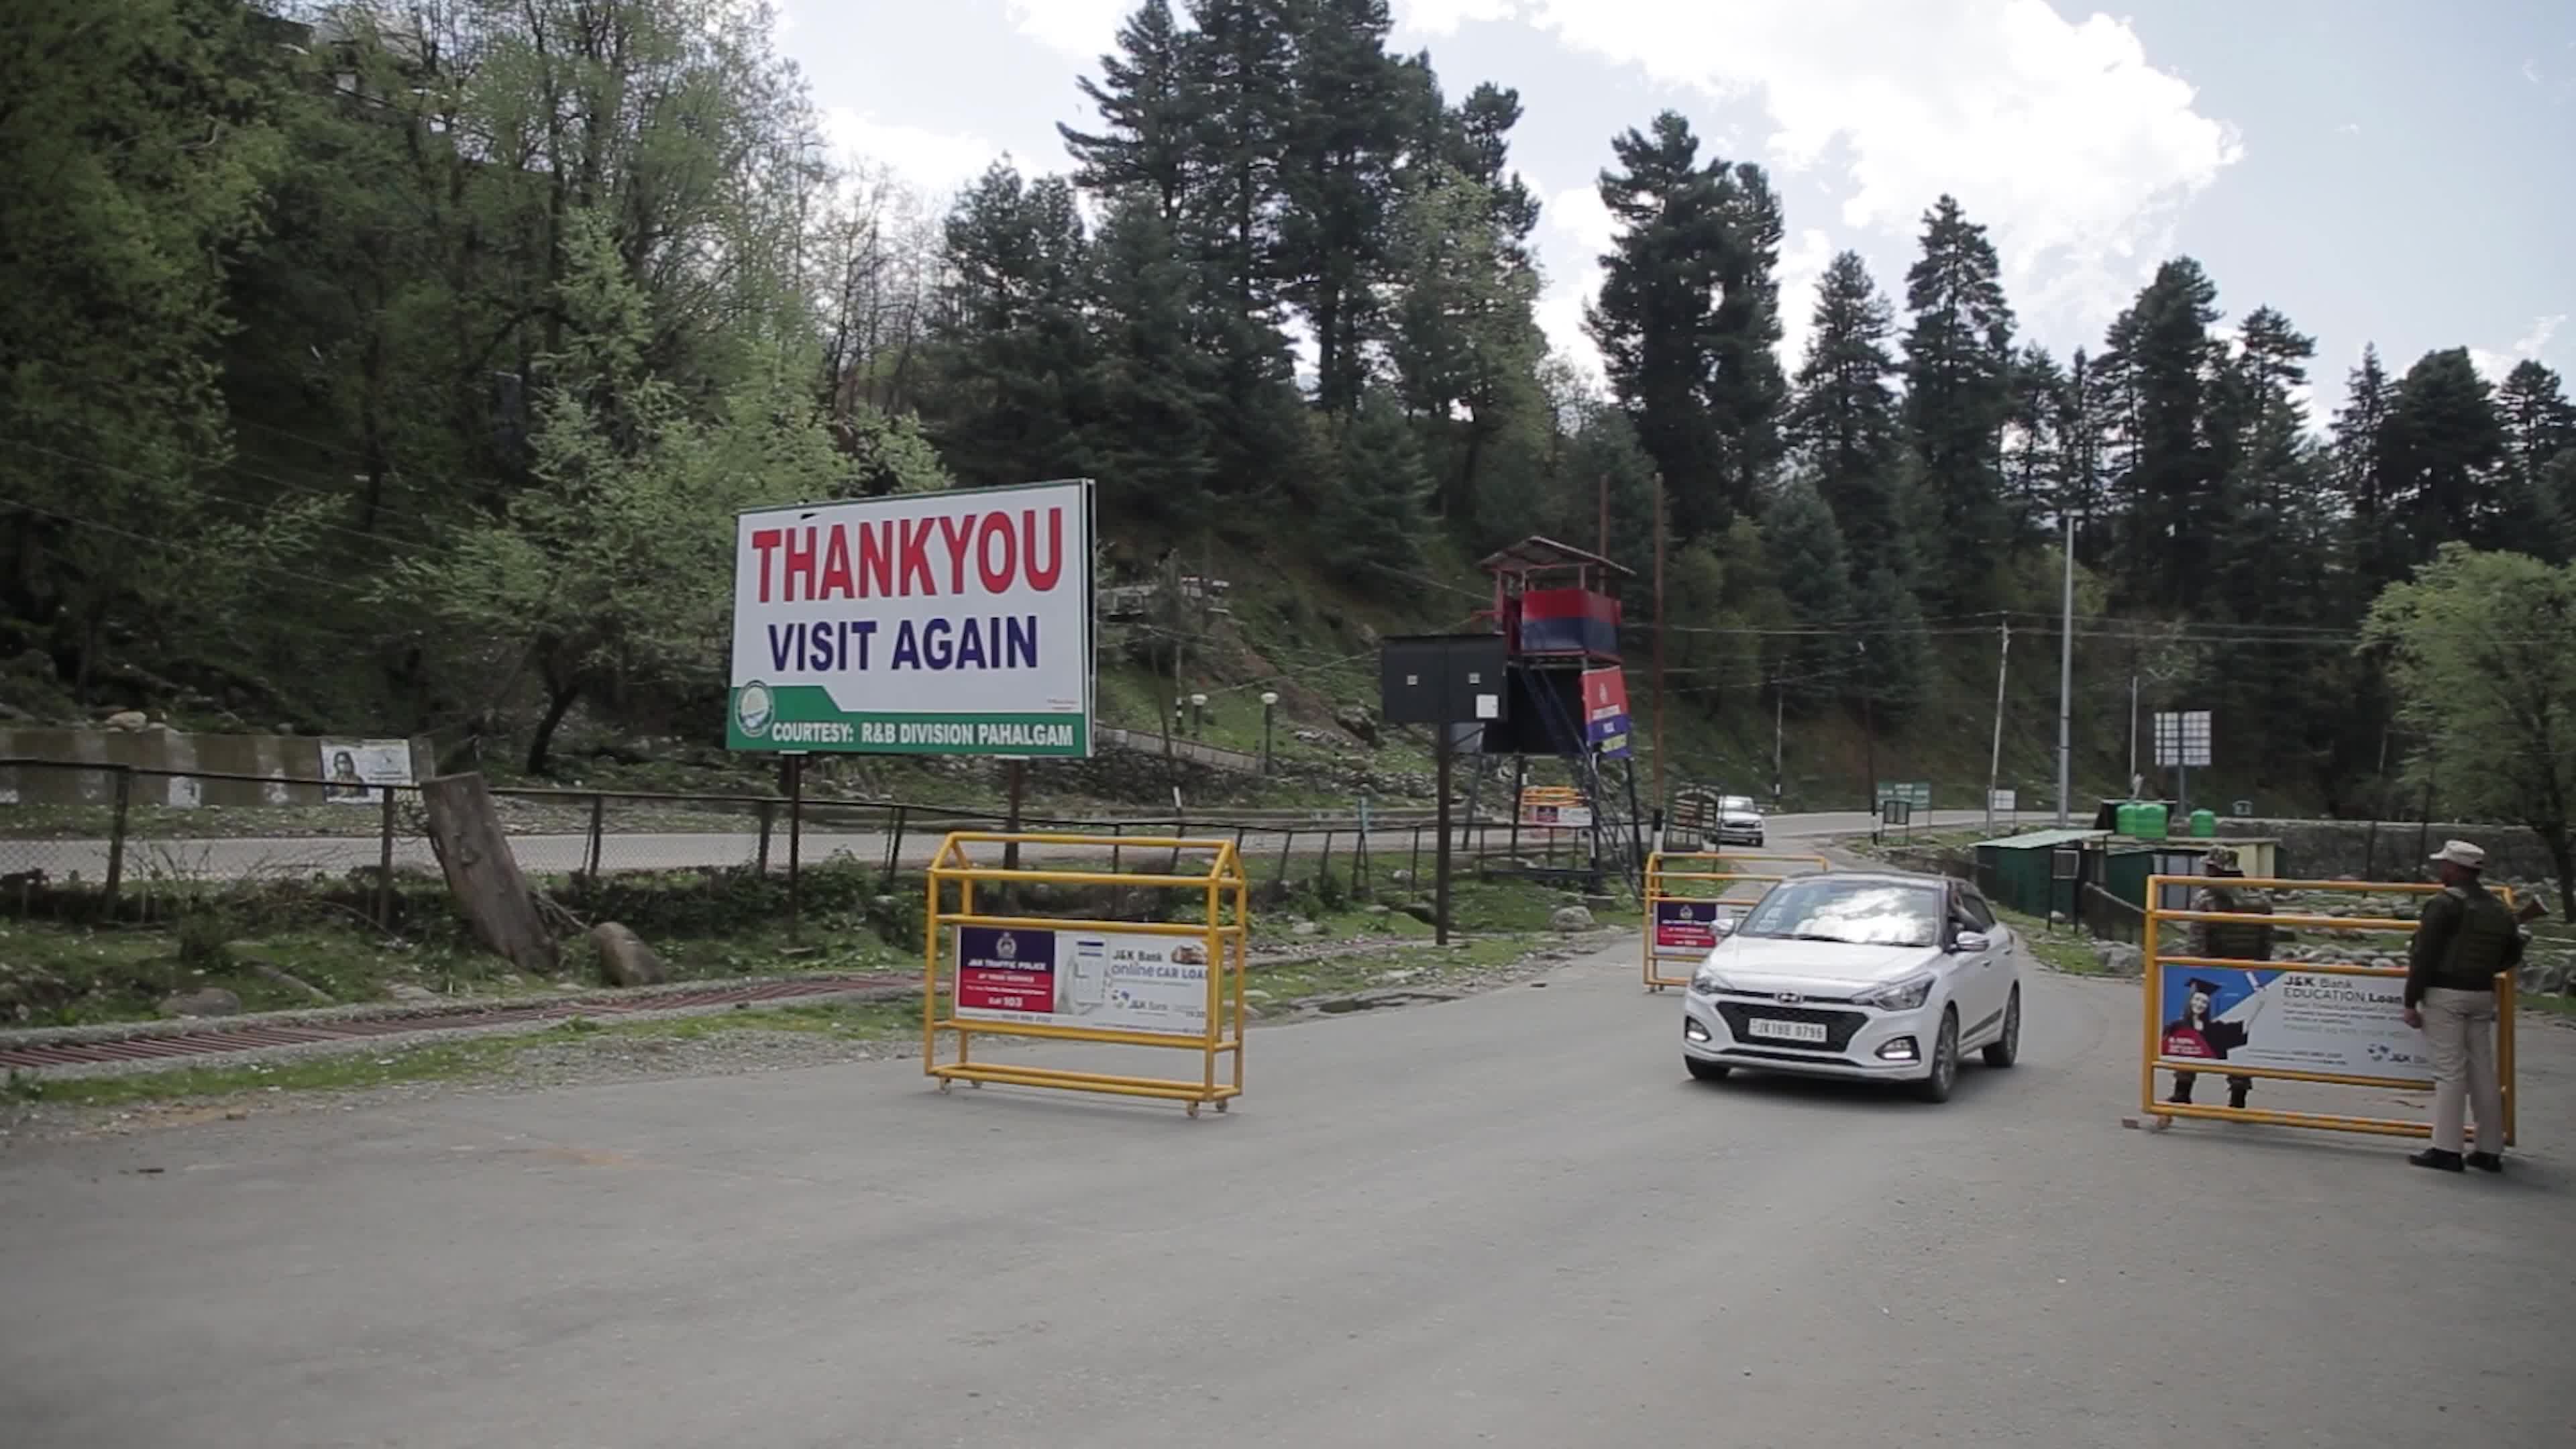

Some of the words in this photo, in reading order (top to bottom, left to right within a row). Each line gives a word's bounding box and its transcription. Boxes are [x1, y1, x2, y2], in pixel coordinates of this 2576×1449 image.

[752, 507, 1062, 603] THANKYOU
[768, 621, 877, 672] VISIT
[891, 615, 1038, 670] AGAIN
[772, 721, 854, 743] COURTESY:
[861, 722, 896, 744] R&B
[900, 722, 973, 745] DIVISION
[978, 723, 1074, 747] PAHALGAM
[1113, 949, 1134, 961] J&K
[1138, 951, 1163, 962] Bank
[1111, 962, 1155, 977] online
[1157, 968, 1179, 978] CAR
[2284, 976, 2315, 987] J&K
[2320, 978, 2353, 988] Bank
[2284, 987, 2365, 1002] EDUCATION
[2369, 993, 2403, 1004] Loan
